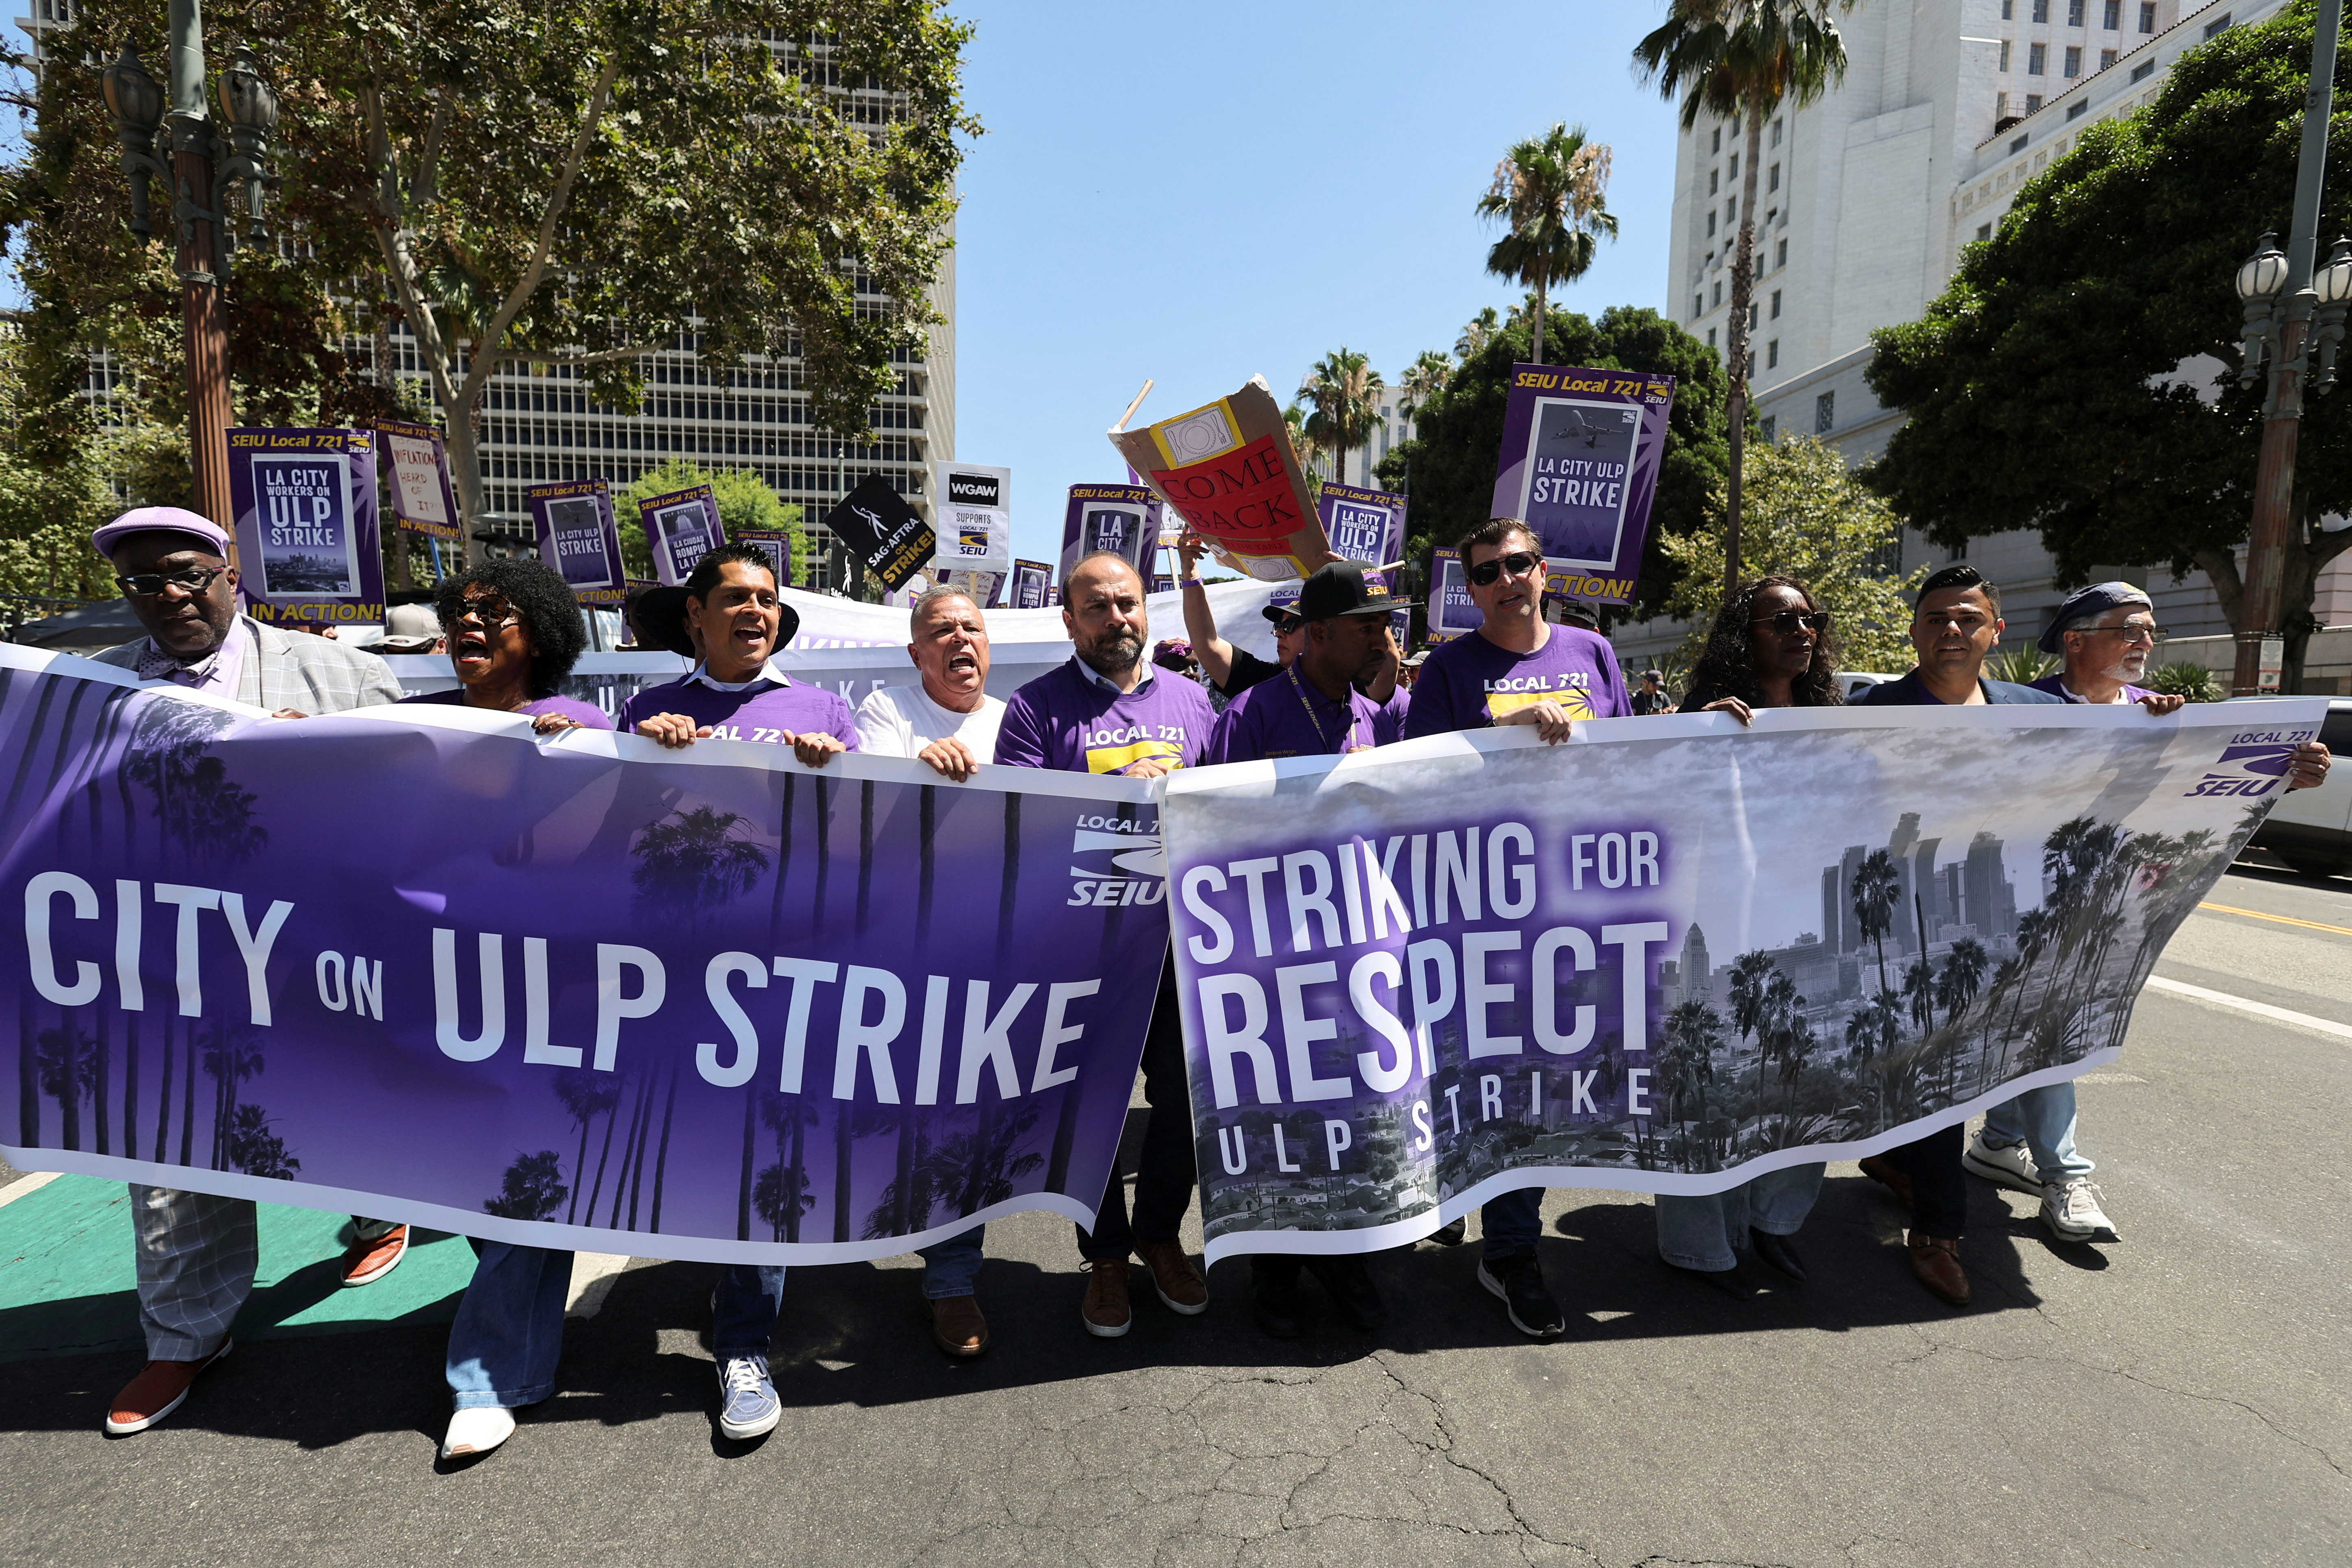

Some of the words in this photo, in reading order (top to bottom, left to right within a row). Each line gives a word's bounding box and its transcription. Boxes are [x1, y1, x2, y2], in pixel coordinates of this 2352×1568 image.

[1515, 372, 1559, 389] SEIU
[1561, 376, 1609, 393] Local
[1612, 380, 1642, 396] 721
[1644, 396, 1667, 404] SEIU
[377, 422, 393, 431] SEIU
[395, 425, 413, 435] Local
[415, 429, 427, 437] 721
[231, 435, 266, 447] SEIU
[270, 435, 310, 447] Local
[316, 435, 343, 448] 721
[1161, 446, 1284, 501] COME
[1537, 458, 1554, 474] LA
[1560, 459, 1593, 476] CITY
[1596, 462, 1624, 478] ULP
[266, 470, 285, 485] LA
[291, 469, 328, 486] CITY
[400, 472, 427, 484] HEARD
[266, 486, 313, 496] WORKERS
[317, 487, 330, 496] ON
[531, 488, 551, 497] SEIU
[554, 486, 574, 495] Local
[577, 484, 592, 493] 721
[951, 483, 997, 497] WGAW
[1072, 489, 1096, 498] SEIU
[1097, 489, 1125, 498] Local
[1127, 490, 1146, 500] 721
[1324, 486, 1347, 496] SEIU
[1347, 490, 1372, 501] Local
[1374, 495, 1391, 504] 721
[1534, 476, 1620, 508] STRIKE
[641, 500, 660, 510] SEIU
[662, 495, 681, 506] Local
[684, 491, 697, 500] 721
[269, 496, 331, 528] ULP
[957, 512, 991, 524] SUPPORTS
[1182, 492, 1297, 529] BACK
[1343, 510, 1354, 521] LA
[1358, 512, 1380, 526] CITY
[400, 519, 412, 530] IN
[414, 522, 460, 538] ACTION!
[557, 531, 566, 540] LA
[567, 529, 583, 539] CITY
[584, 528, 598, 537] ULP
[1100, 515, 1122, 537] LA
[1341, 520, 1368, 531] WORKERS
[271, 528, 335, 546] STRIKE
[683, 535, 705, 546] CIUDAD
[1097, 537, 1122, 550] CITY
[1158, 537, 1178, 546] ACTI
[1339, 527, 1377, 550] ULP
[559, 538, 602, 556] STRIKE
[675, 541, 707, 559] ROMPIÓ
[895, 543, 907, 555] ON
[959, 546, 987, 555] SEIU
[1337, 546, 1374, 563] STRIKE
[678, 557, 690, 570] LA
[690, 554, 704, 566] LE
[882, 530, 935, 584] STRIKE!
[1367, 586, 1389, 596] SEIU
[1544, 573, 1634, 598] CTION!
[1446, 593, 1474, 606] STRI
[252, 604, 275, 620] IN
[280, 604, 382, 621] ACTION!
[1428, 633, 1442, 642] IN
[1290, 675, 1298, 685] 721
[1484, 676, 1552, 692] LOCAL
[1558, 673, 1588, 688] 721
[1301, 697, 1310, 710] SEIU
[1308, 710, 1321, 730] LOCAL
[751, 727, 785, 744] 72
[1085, 725, 1152, 747] LOCAL
[1157, 725, 1184, 741] 721
[2230, 732, 2282, 744] LOCAL
[2286, 730, 2314, 741] 721
[2182, 779, 2280, 797] SEIU
[1076, 815, 1143, 832] LOCAL
[1067, 880, 1166, 906] SEIU
[1181, 821, 1537, 964] STRIKING
[1571, 831, 1660, 891] FOR
[25, 871, 295, 1026] CITY
[316, 950, 383, 1022] ON
[432, 927, 666, 1072] ULP
[696, 951, 1102, 1105] STRIKE
[1197, 921, 1668, 1110] RESPECT
[1218, 1119, 1352, 1175] ULP
[1411, 1068, 1652, 1152] STRIKE
